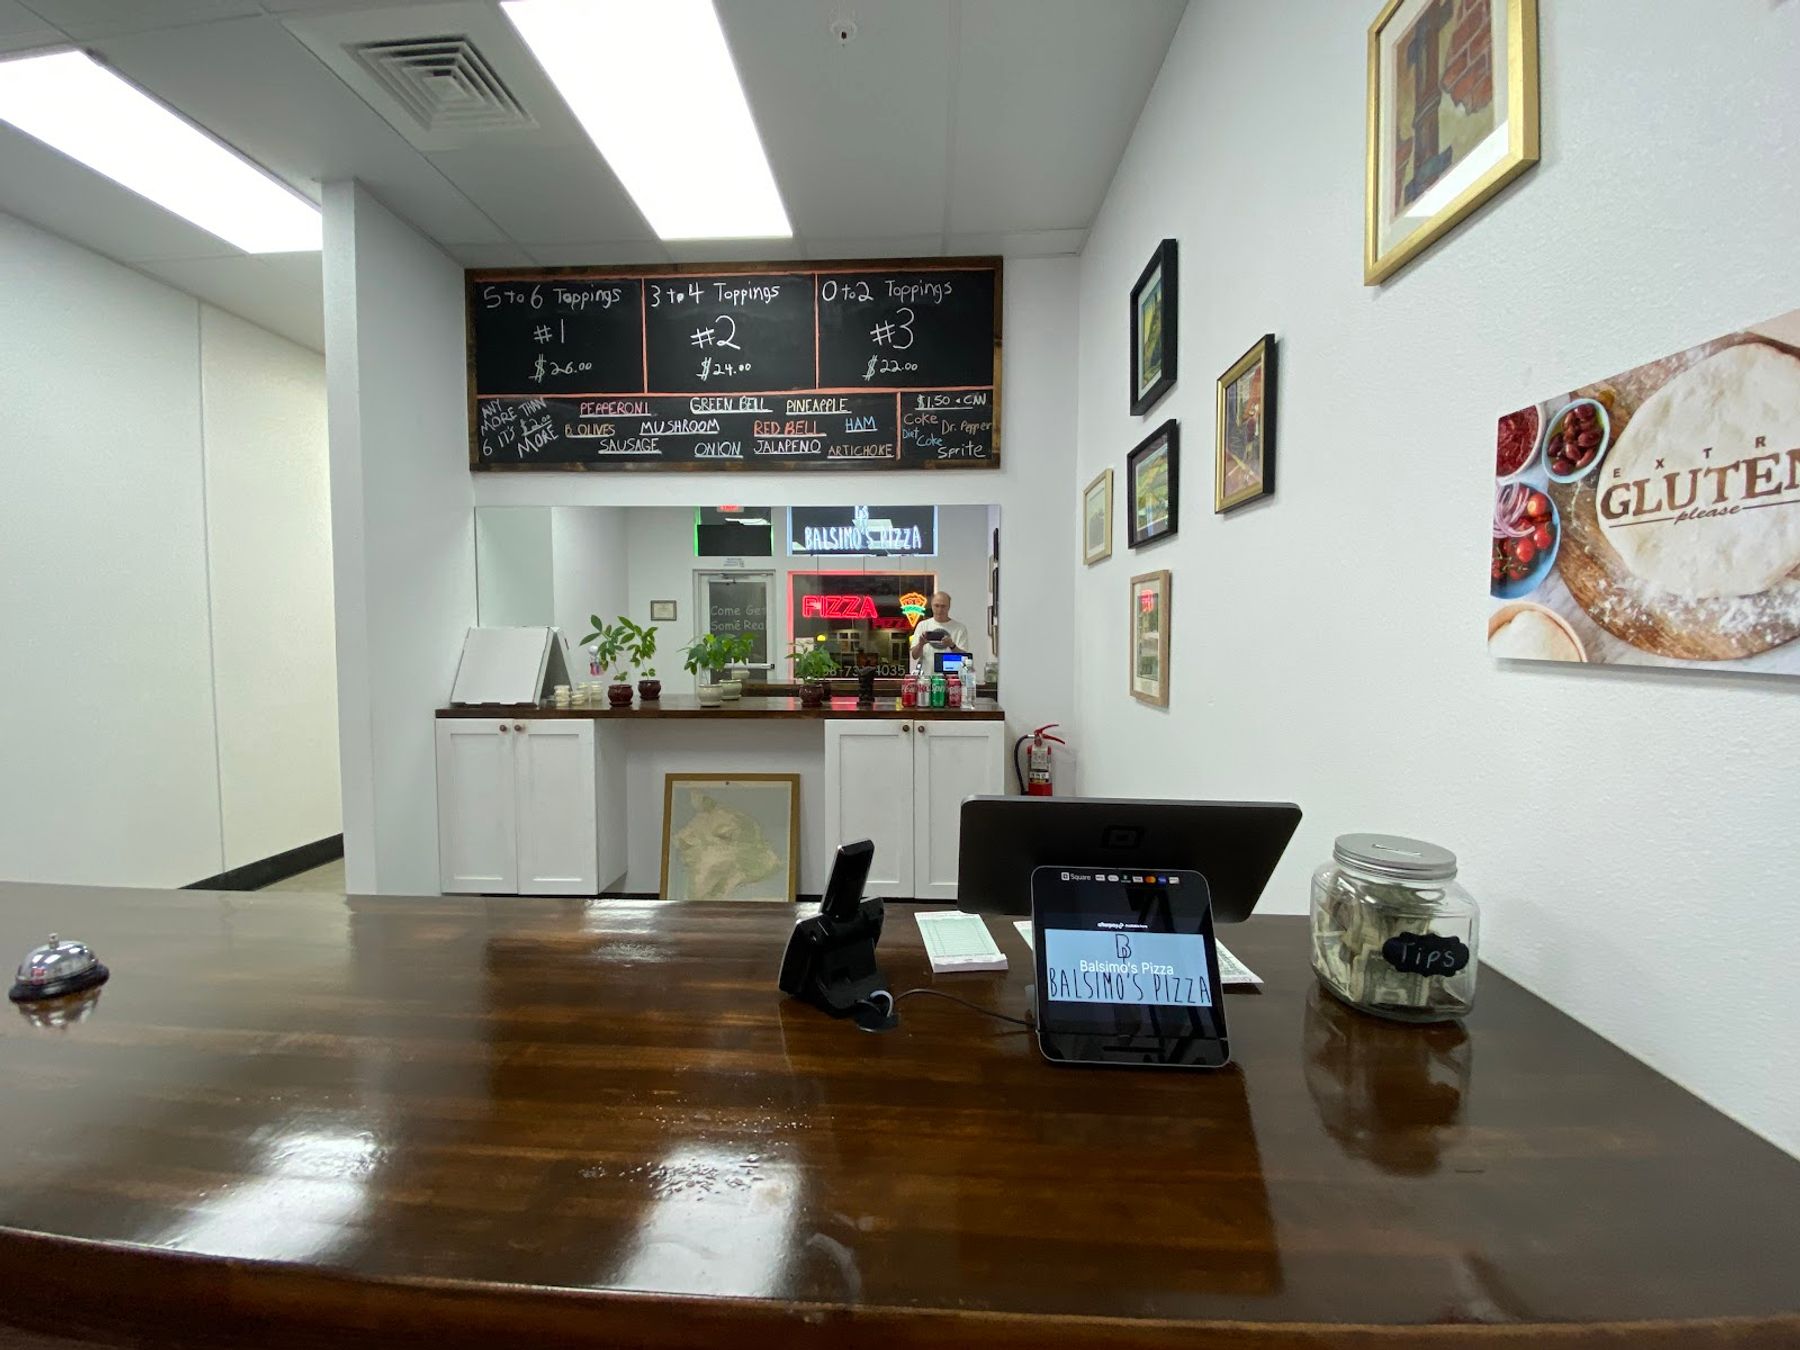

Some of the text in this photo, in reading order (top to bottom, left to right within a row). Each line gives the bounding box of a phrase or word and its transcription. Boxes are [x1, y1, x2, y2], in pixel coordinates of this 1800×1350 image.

[483, 283, 622, 310] 5 to 6 Toppings
[650, 281, 780, 307] 3 to 4 Toppings
[842, 284, 856, 299] to
[856, 281, 874, 302] 2
[884, 279, 953, 304] Toppings
[533, 318, 566, 345] #1
[690, 314, 741, 350] #2
[870, 307, 915, 350] #3
[482, 398, 502, 419] ANY
[579, 400, 650, 417] PEPPERONI
[689, 395, 769, 413] GREEN BELL
[786, 397, 849, 414] PINEAPPLE
[481, 397, 548, 436] MORE THAN
[640, 417, 720, 434] MUSHROOM
[845, 415, 876, 431] HAM
[903, 412, 939, 426] Coke
[577, 422, 616, 437] OLIVES
[753, 419, 818, 436] RED BELL
[941, 419, 992, 435] Dr. Pepper
[517, 424, 559, 459] MORE
[599, 436, 660, 452] SAUSAGE
[902, 427, 943, 447] Diet Coke
[483, 438, 493, 456] 6
[694, 441, 742, 457] ONION
[827, 443, 893, 457] ARTICHOKE
[938, 440, 987, 459] Sprite
[1673, 505, 1740, 525] please
[880, 525, 922, 550] PIZZA
[711, 605, 741, 617] Come
[802, 595, 878, 619] PIZZA
[711, 620, 742, 632] Some
[1400, 942, 1455, 969] Tips
[1080, 959, 1174, 976] Balsimo's Pizza
[1049, 967, 1211, 1004] BALSIMO'S PIZZA
